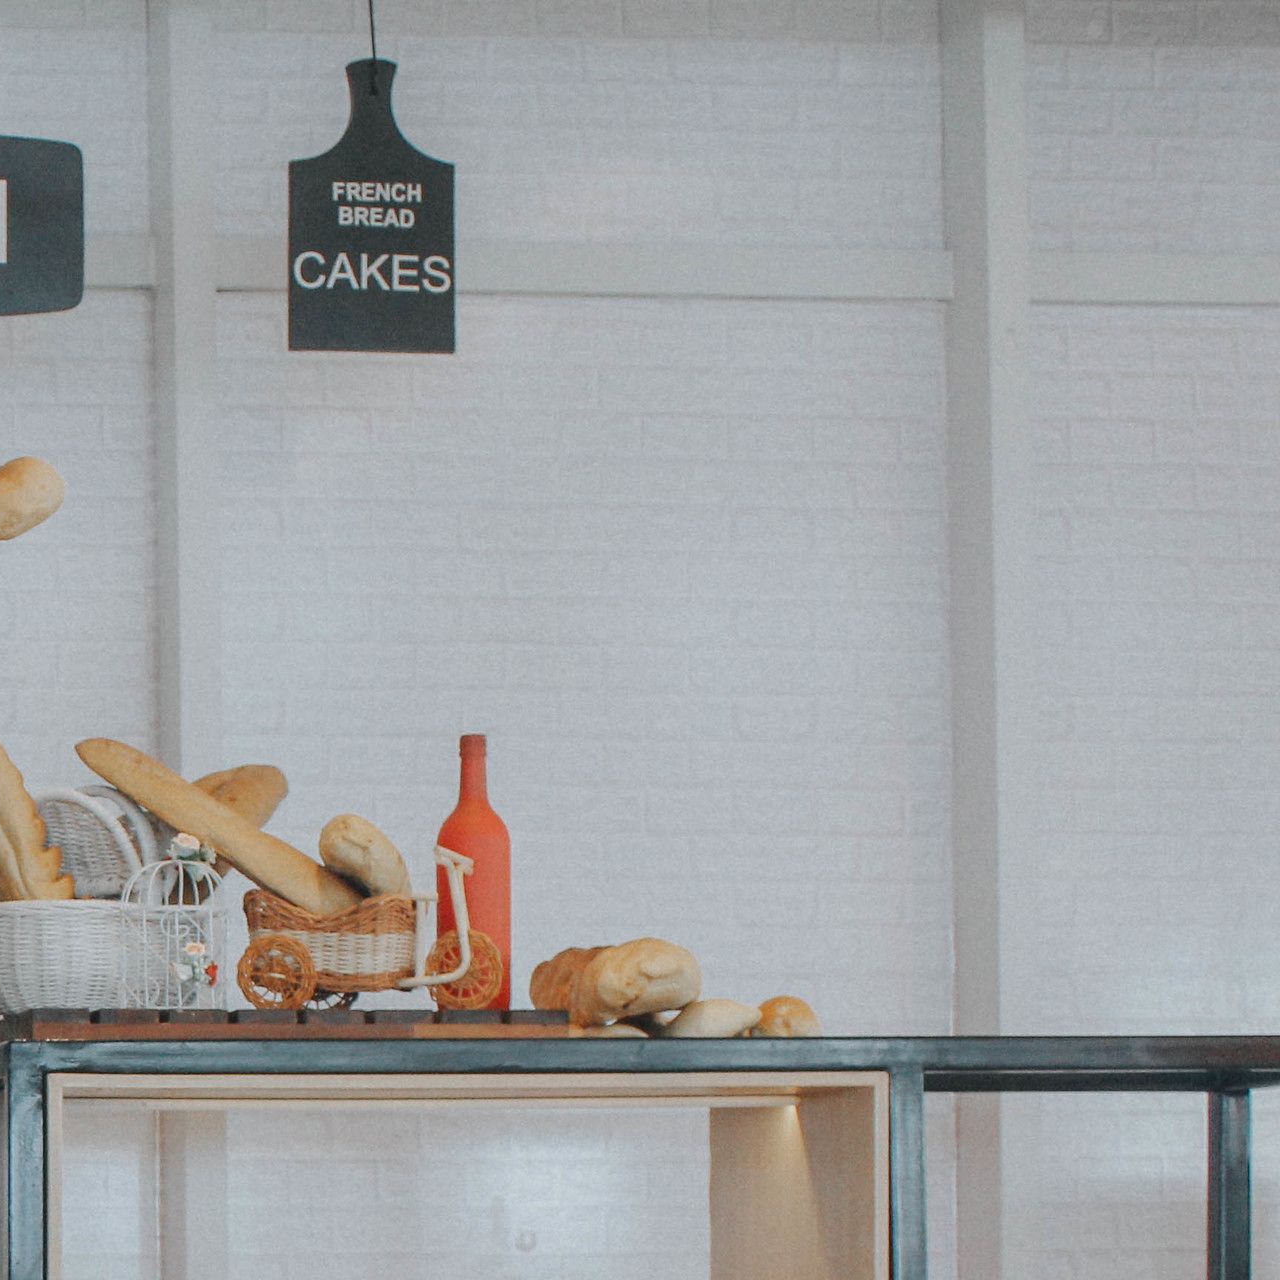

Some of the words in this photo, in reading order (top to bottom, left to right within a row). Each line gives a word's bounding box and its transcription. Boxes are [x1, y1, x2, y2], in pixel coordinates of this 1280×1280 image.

[332, 181, 422, 202] FRENCH
[338, 206, 416, 228] BREAD
[293, 251, 452, 293] CAKES
